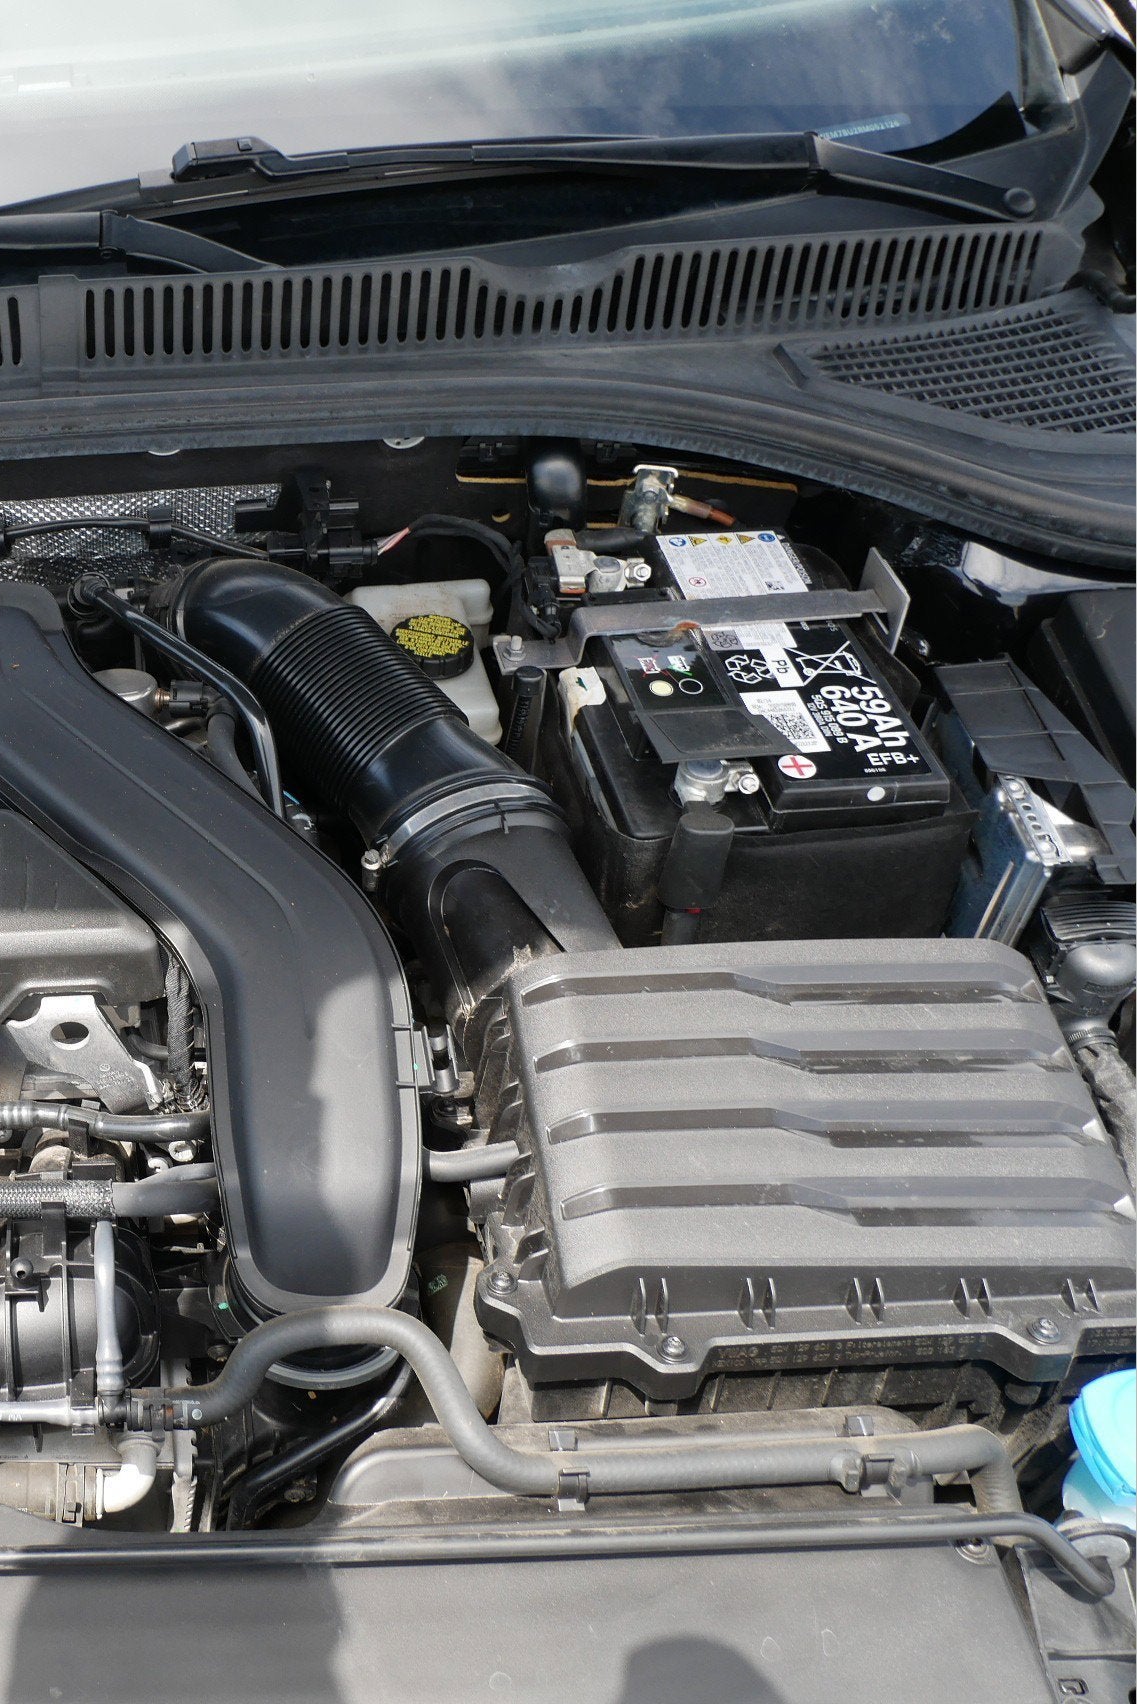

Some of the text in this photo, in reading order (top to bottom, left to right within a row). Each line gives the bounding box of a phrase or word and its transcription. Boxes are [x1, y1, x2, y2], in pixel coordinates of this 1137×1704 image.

[772, 660, 789, 673] Pb
[820, 685, 868, 727] 640
[846, 733, 882, 752] A
[851, 686, 910, 747] 59Ah
[867, 751, 920, 766] EFB+
